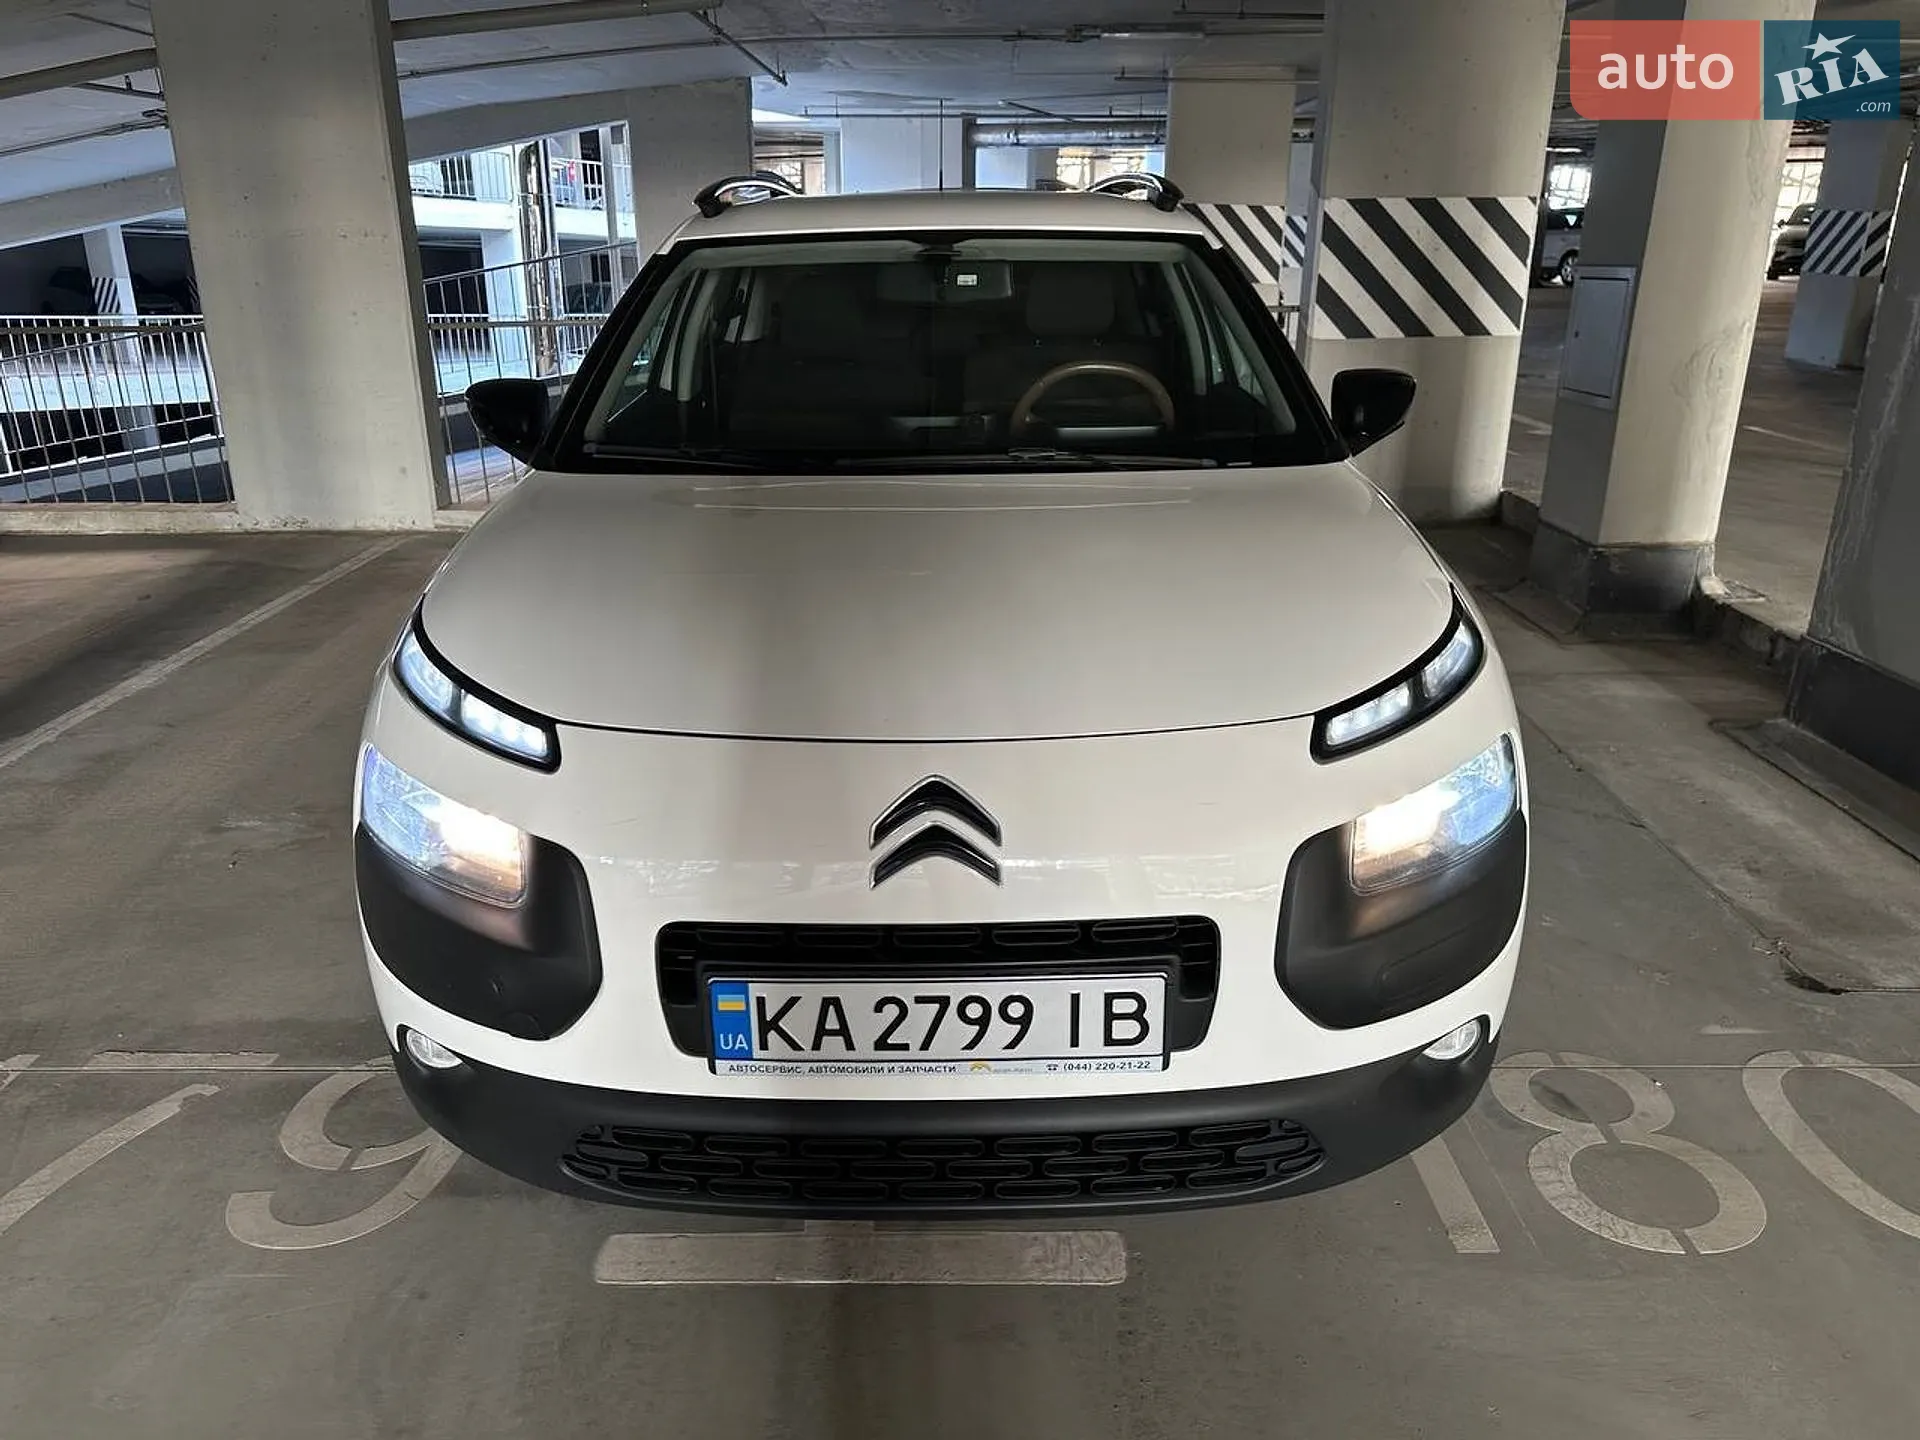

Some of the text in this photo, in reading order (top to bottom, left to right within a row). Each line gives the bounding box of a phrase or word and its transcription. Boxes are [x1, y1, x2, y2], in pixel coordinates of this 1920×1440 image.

[755, 990, 1150, 1052] KA 2799 IB
[719, 1033, 749, 1051] UA
[728, 1064, 806, 1075] АВТОСЕРВИС,
[808, 1065, 885, 1074] АВТОМОБИЛИ
[898, 1064, 957, 1074] ЗАПЧАСТИ
[1096, 1060, 1151, 1071] 220-21-22
